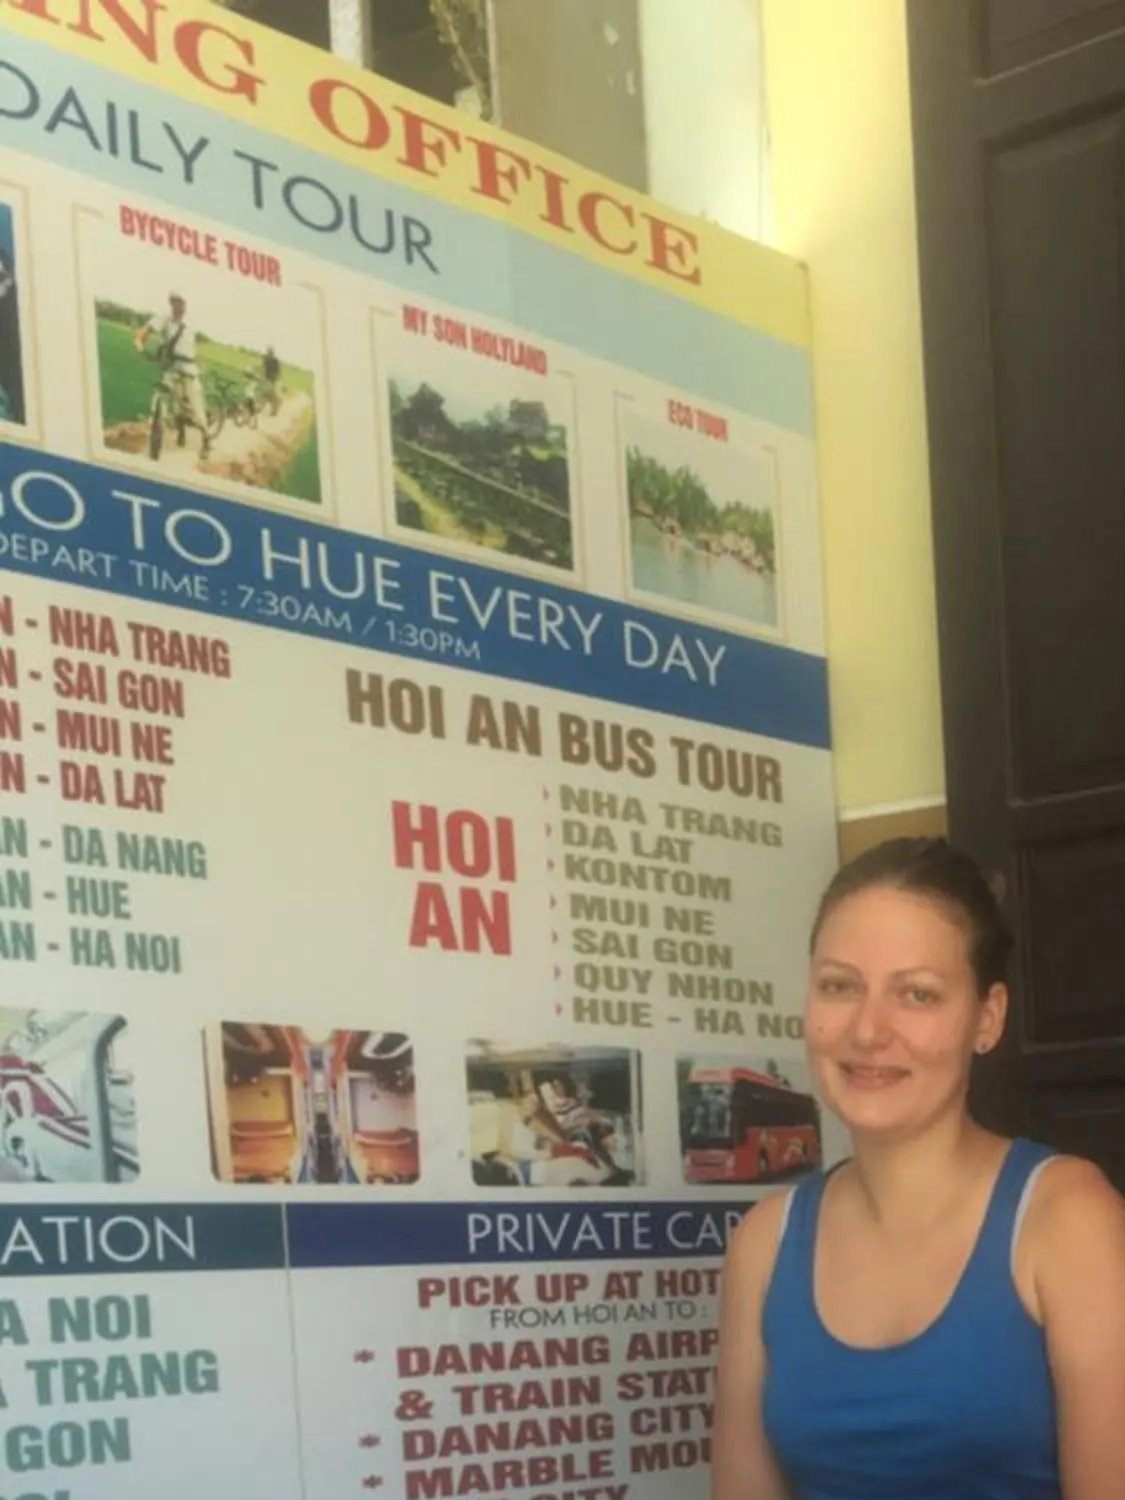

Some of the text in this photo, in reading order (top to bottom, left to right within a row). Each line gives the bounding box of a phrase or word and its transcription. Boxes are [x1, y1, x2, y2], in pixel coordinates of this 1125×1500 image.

[309, 78, 702, 287] OFFICE
[234, 150, 440, 274] TOUR
[119, 205, 282, 287] BYCYCLE TOUR
[403, 304, 428, 336] MY
[433, 315, 467, 349] SON
[112, 490, 231, 566] TO
[261, 527, 404, 611] HUE
[429, 570, 602, 655] EVERY
[624, 621, 726, 686] DAY
[129, 559, 209, 602] TIME
[237, 585, 352, 633] 7:30AM
[49, 605, 119, 658] NHA
[127, 621, 231, 679] TRANG
[53, 658, 107, 706] SAI
[117, 670, 185, 718] GON
[56, 709, 122, 757] MUI
[131, 722, 175, 766] NE
[345, 668, 784, 804] HOI AN BUS TOUR
[60, 760, 105, 806] DA
[114, 769, 166, 814] LAT
[391, 800, 517, 882] HOI
[560, 784, 783, 848] NHA TRANG
[561, 819, 695, 865] DA LAT
[62, 824, 108, 868] DA
[117, 831, 208, 880] NANG
[564, 854, 732, 902] KONTOM
[66, 876, 132, 920] HUE
[408, 881, 513, 956] AN
[569, 893, 716, 936] MUI NE
[70, 927, 116, 969] HA
[125, 932, 182, 974] NOI
[572, 928, 734, 970] SAI GON
[574, 962, 775, 1007] QUY NHON
[572, 996, 654, 1029] HUE
[694, 1007, 746, 1036] HA
[1, 1215, 196, 1264] ATION
[467, 1212, 651, 1254] PRIVATE
[416, 1274, 522, 1309] PICK
[536, 1273, 589, 1303] UP
[603, 1270, 642, 1301] AT
[490, 1305, 566, 1329] FROM
[573, 1302, 618, 1326] HOI
[624, 1302, 657, 1322] AN
[663, 1301, 696, 1320] TO
[48, 1294, 152, 1344] NOI
[26, 1348, 220, 1407] TRANG
[396, 1334, 611, 1379] DANANG
[394, 1366, 718, 1421] & TRAIN STAT
[6, 1416, 132, 1473] GON
[402, 1412, 614, 1462] DANANG
